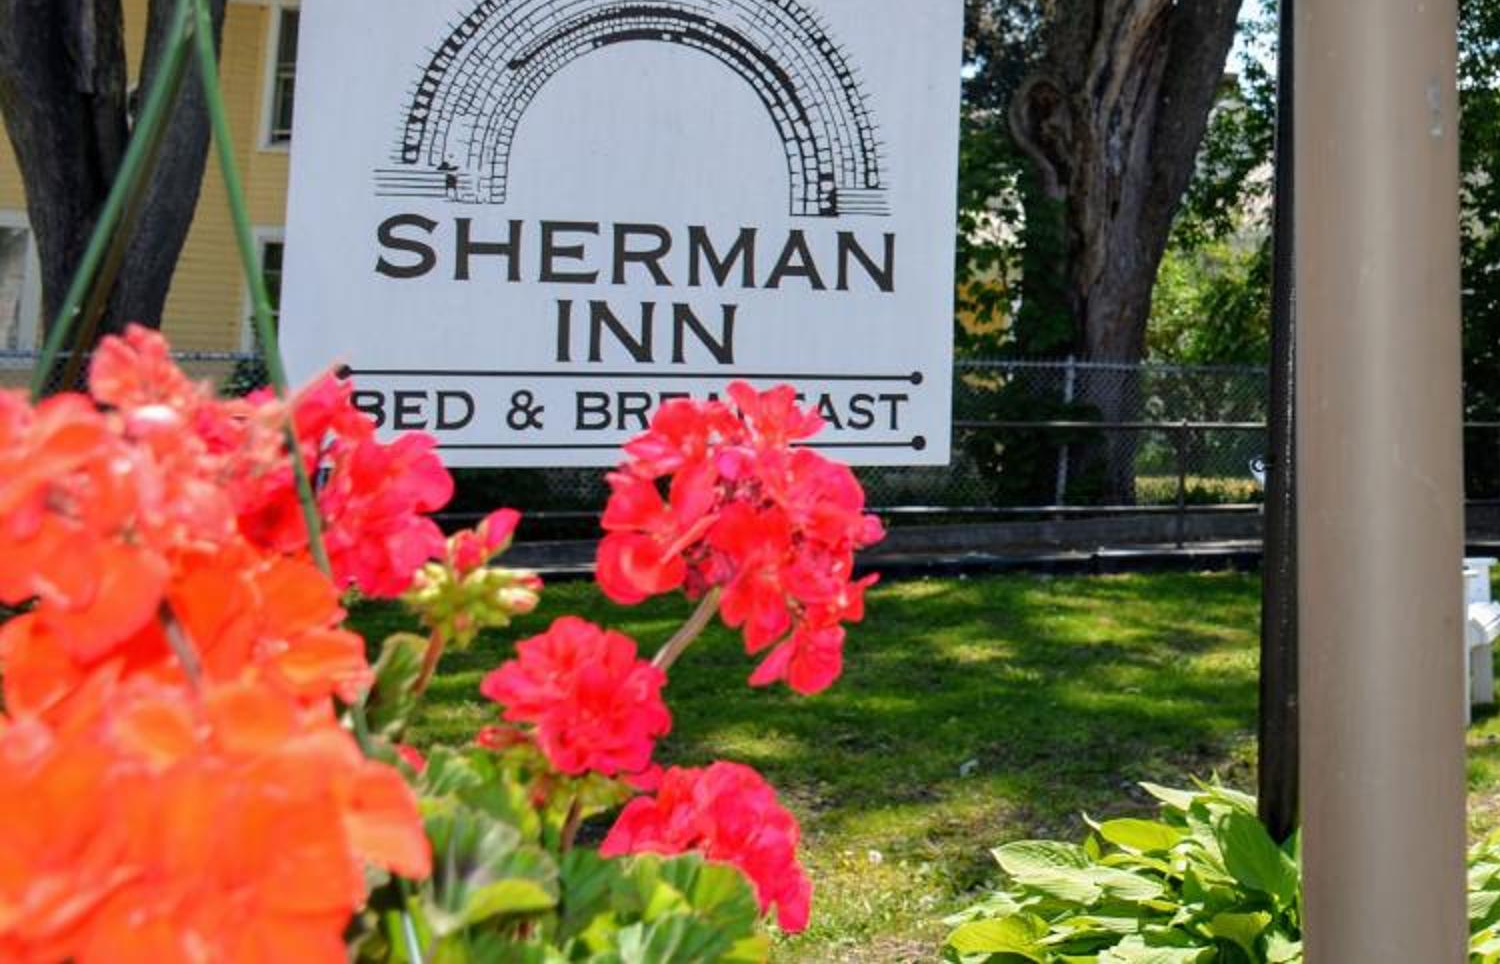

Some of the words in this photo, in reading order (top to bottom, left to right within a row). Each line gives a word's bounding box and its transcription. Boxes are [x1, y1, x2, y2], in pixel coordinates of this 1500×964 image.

[375, 213, 895, 292] SHERMAN
[555, 299, 737, 364] INN
[350, 390, 475, 430] BED
[506, 389, 545, 431] &
[575, 391, 908, 431] BRAST
